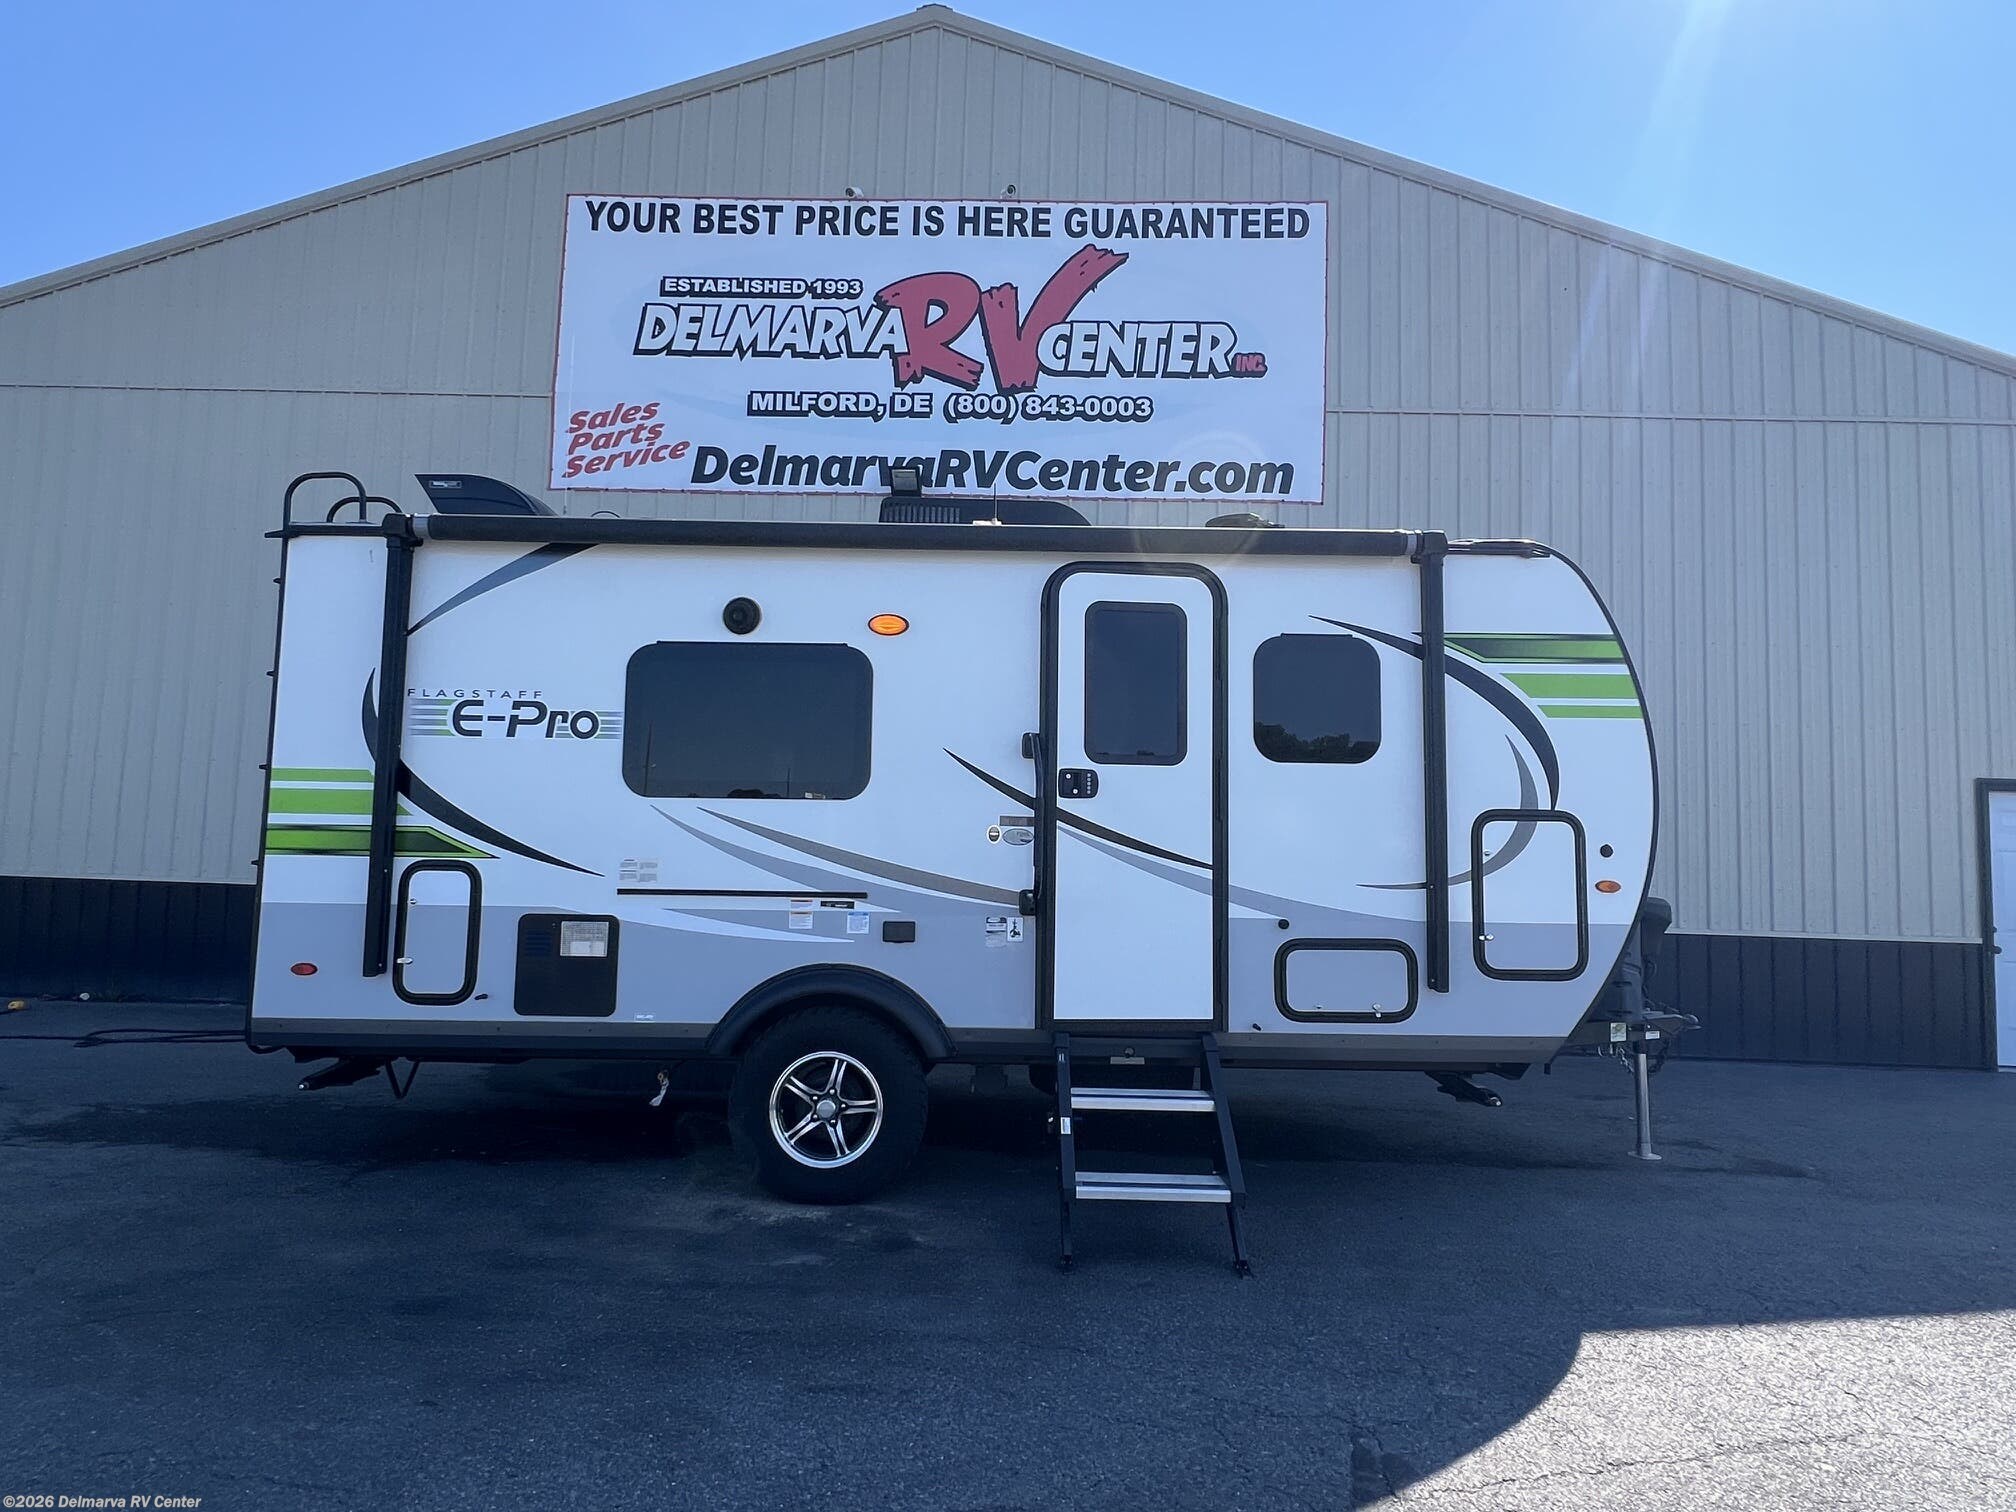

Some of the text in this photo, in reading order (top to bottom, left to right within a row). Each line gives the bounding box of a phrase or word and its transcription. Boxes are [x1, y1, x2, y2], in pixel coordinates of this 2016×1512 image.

[585, 201, 1310, 239] YOUR BEST PRICE IS HERE GUARANTEED
[661, 276, 864, 300] ESTABLISHED 1993
[633, 303, 911, 361] DELMARVA
[873, 243, 1129, 395] RV
[1036, 320, 1238, 379] CENTER
[566, 402, 661, 433] Sales
[747, 391, 1155, 424] MILFORD, DE (800) 843-0003
[567, 423, 665, 455] Parts
[562, 441, 691, 478] Service
[690, 445, 1295, 494] DelmarvaRVCenter.com
[407, 688, 543, 699] FLAGSTAFF
[452, 699, 600, 740] E-Pro
